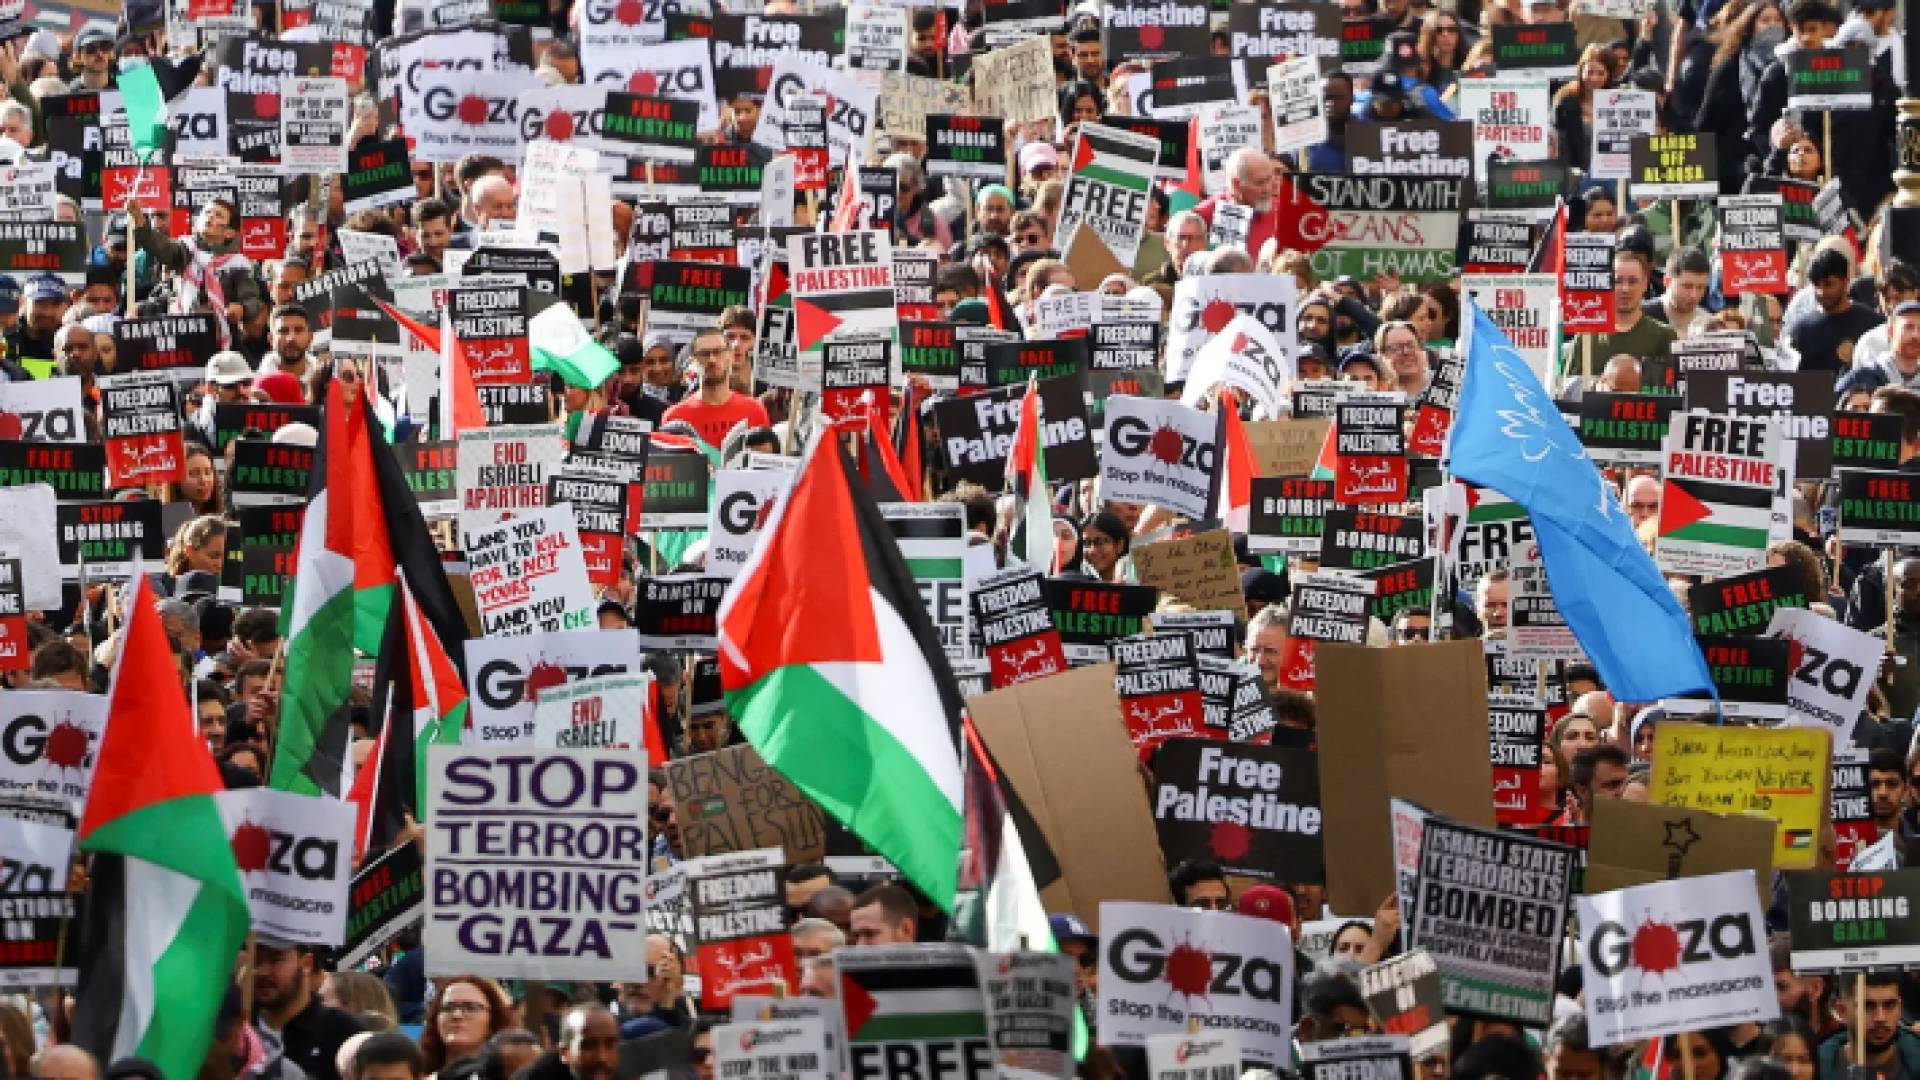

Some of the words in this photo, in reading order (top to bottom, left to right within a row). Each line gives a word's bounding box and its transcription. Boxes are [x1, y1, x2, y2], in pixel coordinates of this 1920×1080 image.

[744, 19, 800, 42] Free
[1260, 8, 1314, 32] Free
[242, 42, 296, 69] Free
[1234, 32, 1340, 57] Palestine
[632, 100, 671, 119] FREE
[606, 114, 695, 141] PALESTINE
[1381, 128, 1439, 154] Free
[1068, 178, 1145, 224] FREE
[1312, 178, 1394, 208] STAND
[1404, 178, 1460, 208] WITH
[1725, 209, 1777, 225] FREEDOM
[1299, 214, 1423, 247] GAZANS,
[804, 232, 880, 266] FREE
[1362, 250, 1454, 279] HAMAS
[680, 269, 721, 286] FREE
[796, 267, 890, 291] PALESTINE
[456, 290, 520, 308] FREEDOM
[654, 284, 746, 305] PALESTINE
[1496, 289, 1525, 308] END
[121, 318, 207, 337] SANCTIONS
[456, 316, 524, 337] PALESTINE
[913, 327, 952, 346] FREE
[1099, 326, 1151, 343] FREEDOM
[156, 337, 175, 351] ON
[829, 344, 884, 361] FREEDOM
[1020, 350, 1055, 364] FREE
[1093, 350, 1154, 368] PALESTINE
[108, 387, 171, 408] FREEDOM
[1727, 377, 1794, 407] Free
[1343, 407, 1397, 425] FREEDOM
[1612, 400, 1656, 420] FREE
[108, 413, 176, 434] PALESTINE
[1584, 420, 1670, 441] PALESTIN
[1685, 417, 1767, 454] FREE
[493, 442, 525, 464] END
[1110, 416, 1216, 473] Gza
[1339, 433, 1401, 453] PALESTINE
[28, 449, 72, 469] FREE
[416, 449, 453, 470] FRE
[1669, 453, 1773, 484] PALESTINE
[0, 470, 100, 491] PALESTINE
[477, 463, 541, 485] ISRAELI
[1107, 467, 1140, 486] Stop
[1143, 470, 1166, 484] the
[554, 479, 620, 503] FREEDOM
[1281, 481, 1327, 497] STOP
[1868, 479, 1910, 500] FREE
[80, 506, 124, 524] STOP
[1355, 514, 1401, 533] STOP
[64, 524, 144, 542] BOMBING
[464, 529, 508, 552] LAND
[512, 518, 546, 540] YOU
[1335, 532, 1419, 556] BOMBING
[469, 545, 508, 570] HAVE
[512, 540, 533, 557] TO
[715, 547, 749, 564] Stop
[471, 567, 503, 587] FOR
[507, 560, 521, 578] IS
[523, 548, 561, 574] NOT
[979, 580, 1042, 613] FREEDOM
[1071, 590, 1120, 610] FREE
[1300, 590, 1365, 612] FREEDOM
[1721, 578, 1772, 609] FREE
[483, 607, 528, 635] LAND
[529, 596, 566, 619] YOU
[563, 607, 592, 630] DIE
[682, 599, 704, 615] ON
[1698, 594, 1810, 636] PALESTINE
[984, 609, 1054, 646] PALESTINE
[1290, 617, 1364, 644] PALESTINE
[1113, 638, 1186, 662] FREEDOM
[1708, 647, 1749, 666] FREE
[1115, 667, 1196, 691] PALESTINE
[571, 696, 602, 723] END
[481, 725, 519, 741] Stop
[1199, 747, 1282, 790] Free
[1755, 766, 1814, 789] NEVER
[441, 755, 638, 808] STOP
[1156, 784, 1322, 835] Palestine
[434, 821, 642, 860] TERROR
[250, 887, 334, 911] massacre
[434, 869, 641, 914] BOMBING
[700, 872, 777, 902] FREEDOM
[1829, 876, 1884, 898] STOP
[1424, 880, 1558, 938] BOMBED
[1809, 896, 1910, 921] BOMBING
[700, 906, 785, 941] PALESTINE
[1832, 920, 1886, 942] GAZA
[458, 914, 613, 959] GAZA
[1589, 912, 1756, 977] Gza
[1108, 927, 1281, 1003] Gza
[1595, 993, 1629, 1014] Stop
[1631, 989, 1666, 1009] the
[1668, 975, 1764, 1002] massacre
[1108, 999, 1153, 1019] Stop
[1157, 1004, 1184, 1024] the
[1188, 1010, 1281, 1037] massacre
